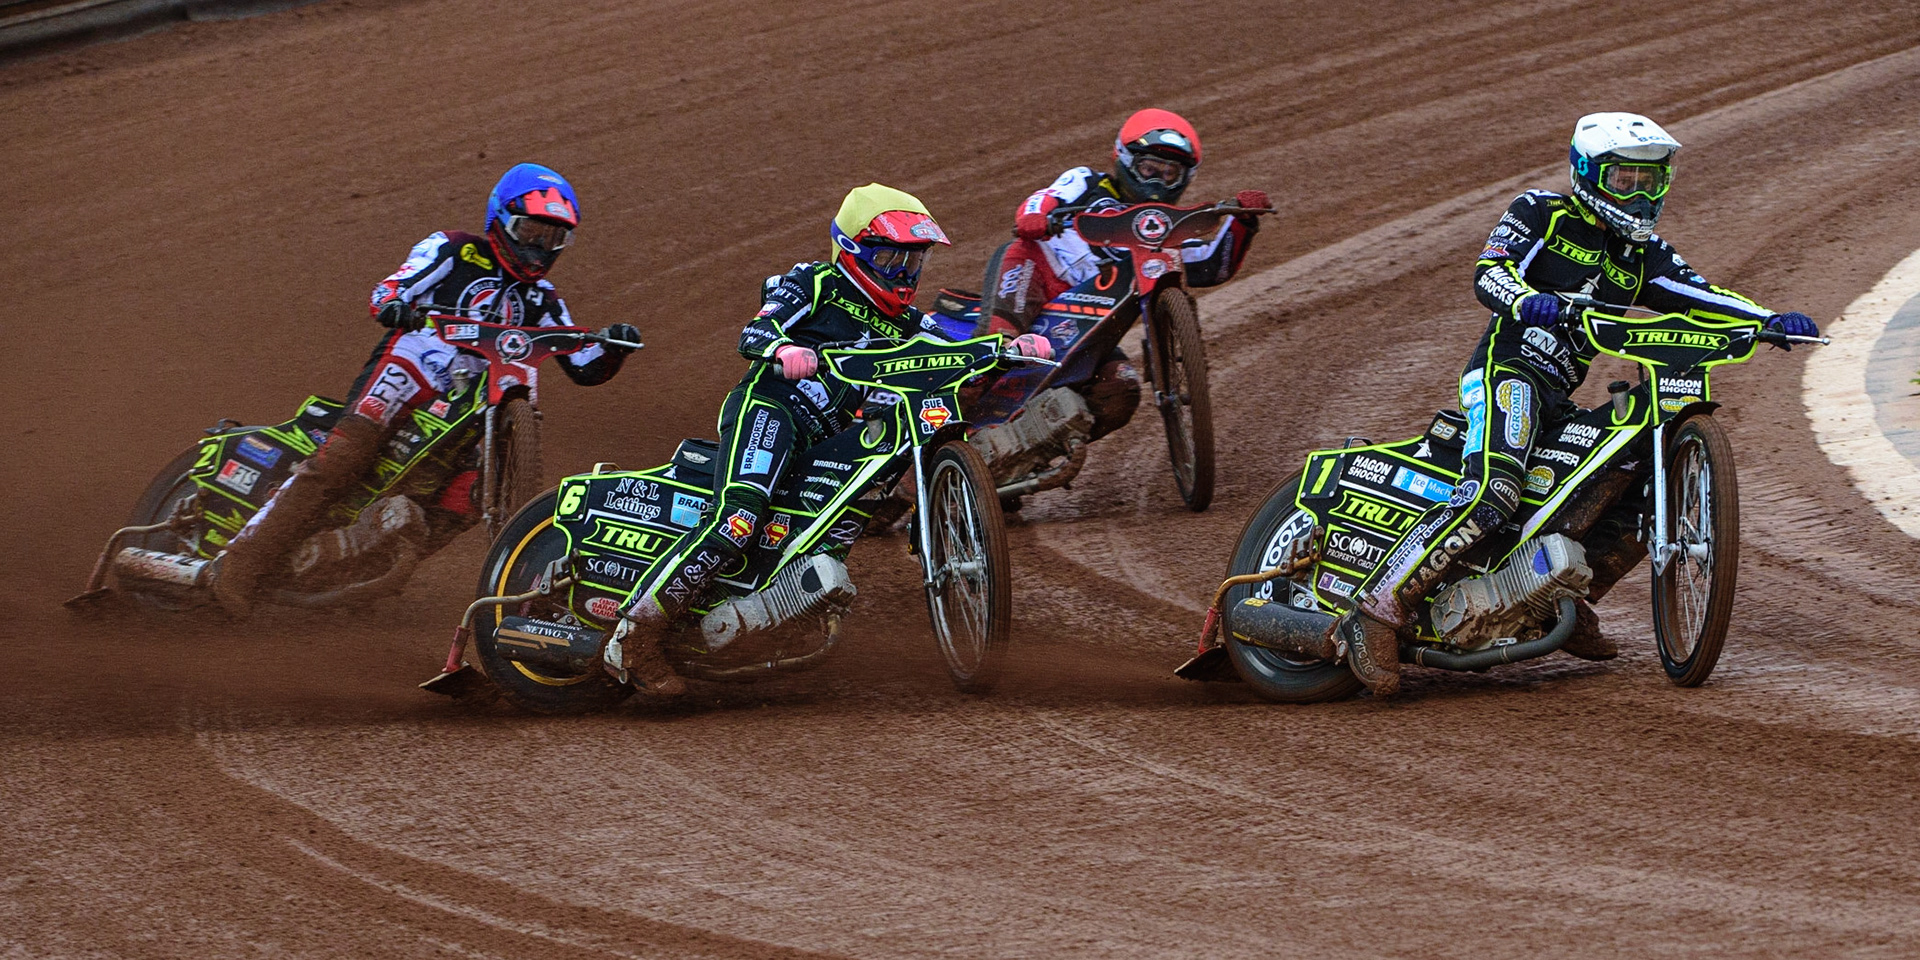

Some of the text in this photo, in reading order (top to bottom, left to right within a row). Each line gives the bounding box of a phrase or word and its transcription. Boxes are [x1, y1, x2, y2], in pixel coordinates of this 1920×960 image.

[1560, 241, 1601, 264] TRU
[1477, 274, 1516, 306] SHOCKS
[1485, 265, 1529, 295] HAGON
[1635, 331, 1721, 348] TRU MIX
[882, 354, 967, 371] TRU MIX
[1659, 377, 1703, 389] HAGON
[1659, 385, 1702, 396] SHOCKS
[924, 400, 943, 409] SUE
[1510, 383, 1521, 441] AGROMIX
[743, 408, 770, 471] BRADWORTHY
[763, 419, 780, 450] GLASS
[1558, 433, 1595, 449] SHOCKS
[1562, 422, 1601, 440] HAGON
[193, 443, 219, 469] 2
[812, 459, 852, 472] BRADLEY
[1352, 454, 1394, 476] HAGON
[1310, 458, 1337, 495] 1
[1347, 466, 1387, 485] SHOCKS
[1413, 475, 1426, 489] Ice
[616, 477, 661, 500] N & L
[558, 484, 587, 516] 6
[603, 491, 661, 521] Lettings
[738, 509, 756, 524] SUE
[773, 514, 790, 525] SUE
[1349, 497, 1400, 527] TRU
[601, 524, 664, 553] TRU
[1326, 548, 1358, 566] PROPERTY
[665, 577, 691, 604] N
[697, 551, 721, 571] L
[523, 624, 575, 641] NETWOK
